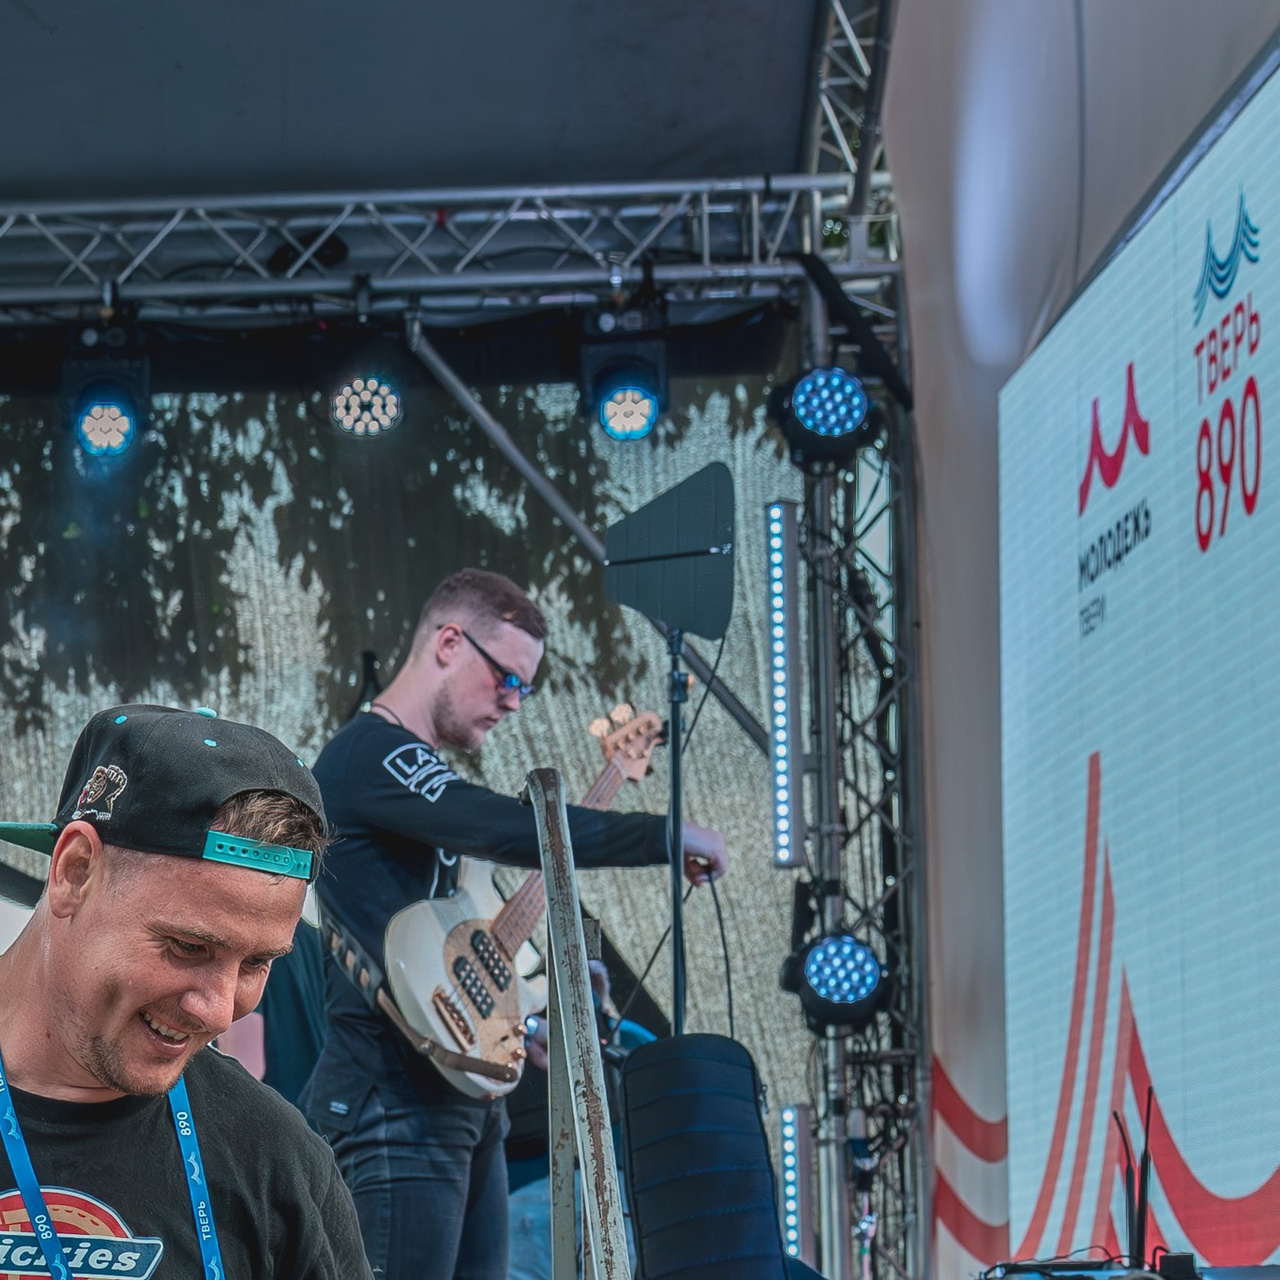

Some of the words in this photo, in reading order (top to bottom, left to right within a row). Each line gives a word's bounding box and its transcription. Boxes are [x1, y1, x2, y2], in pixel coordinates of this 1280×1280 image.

[1193, 291, 1261, 405] ТВЕРЬ
[1195, 375, 1261, 553] 890
[176, 1111, 192, 1137] 890
[34, 1213, 53, 1241] 890
[197, 1200, 213, 1242] ТВЕРЬ
